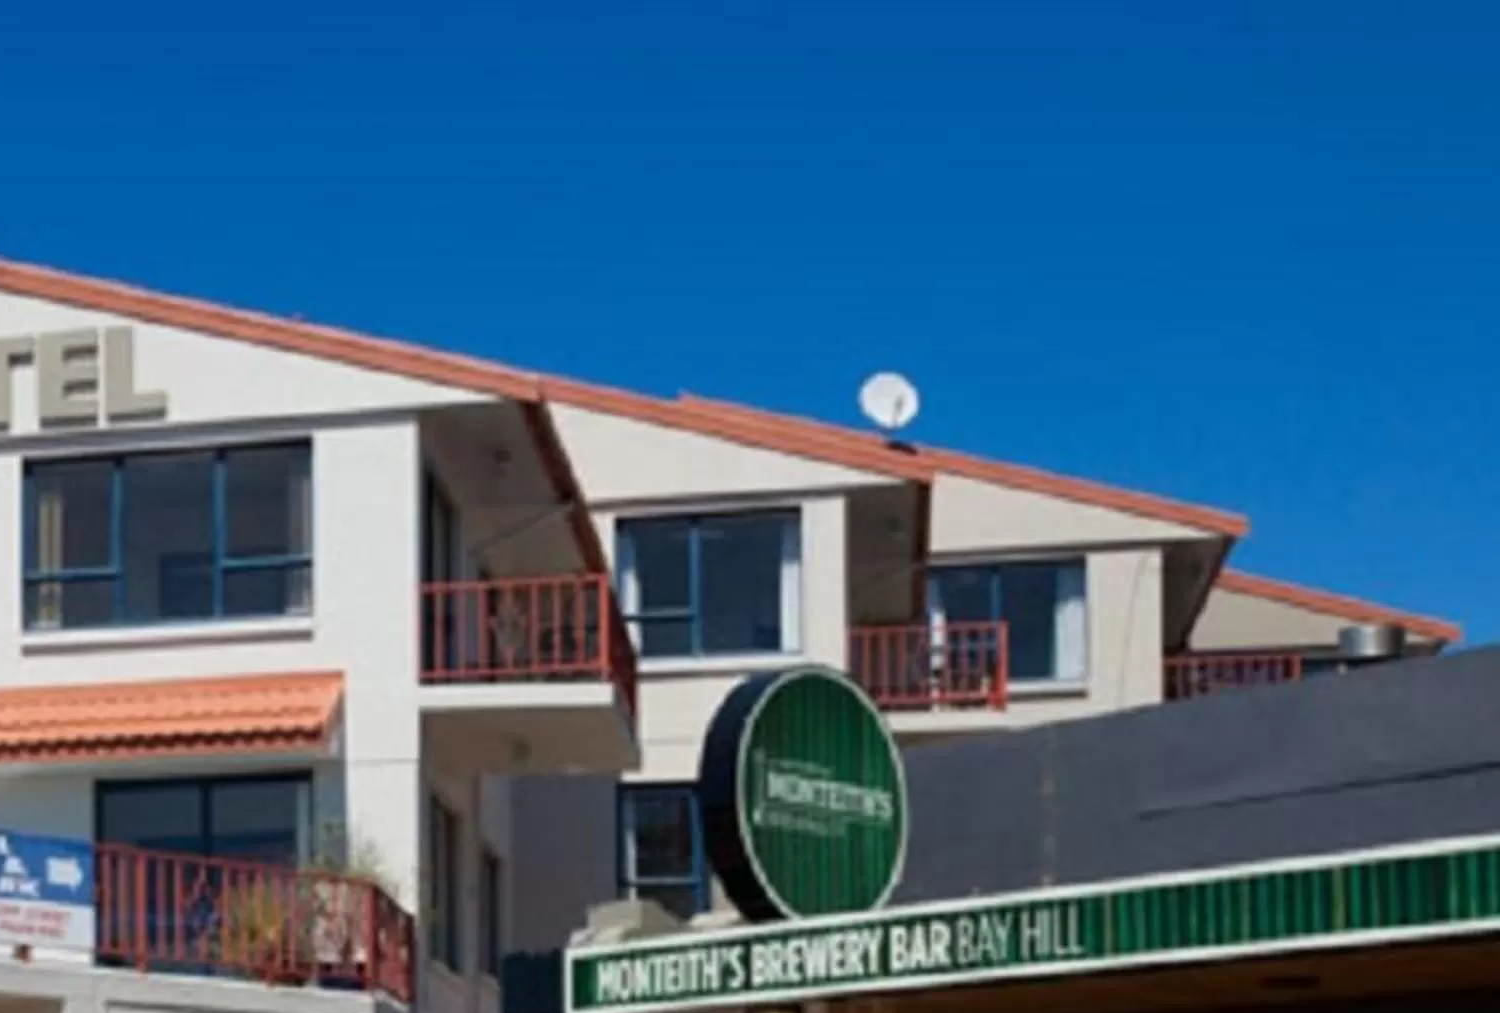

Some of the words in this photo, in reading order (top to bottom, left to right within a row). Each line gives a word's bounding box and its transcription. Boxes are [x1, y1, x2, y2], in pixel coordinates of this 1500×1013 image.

[595, 944, 746, 1003] MONTEITH'S
[750, 925, 885, 987] BREWERY
[890, 917, 953, 970] BAR
[955, 912, 1013, 965] BAY
[1020, 903, 1084, 958] HILL
